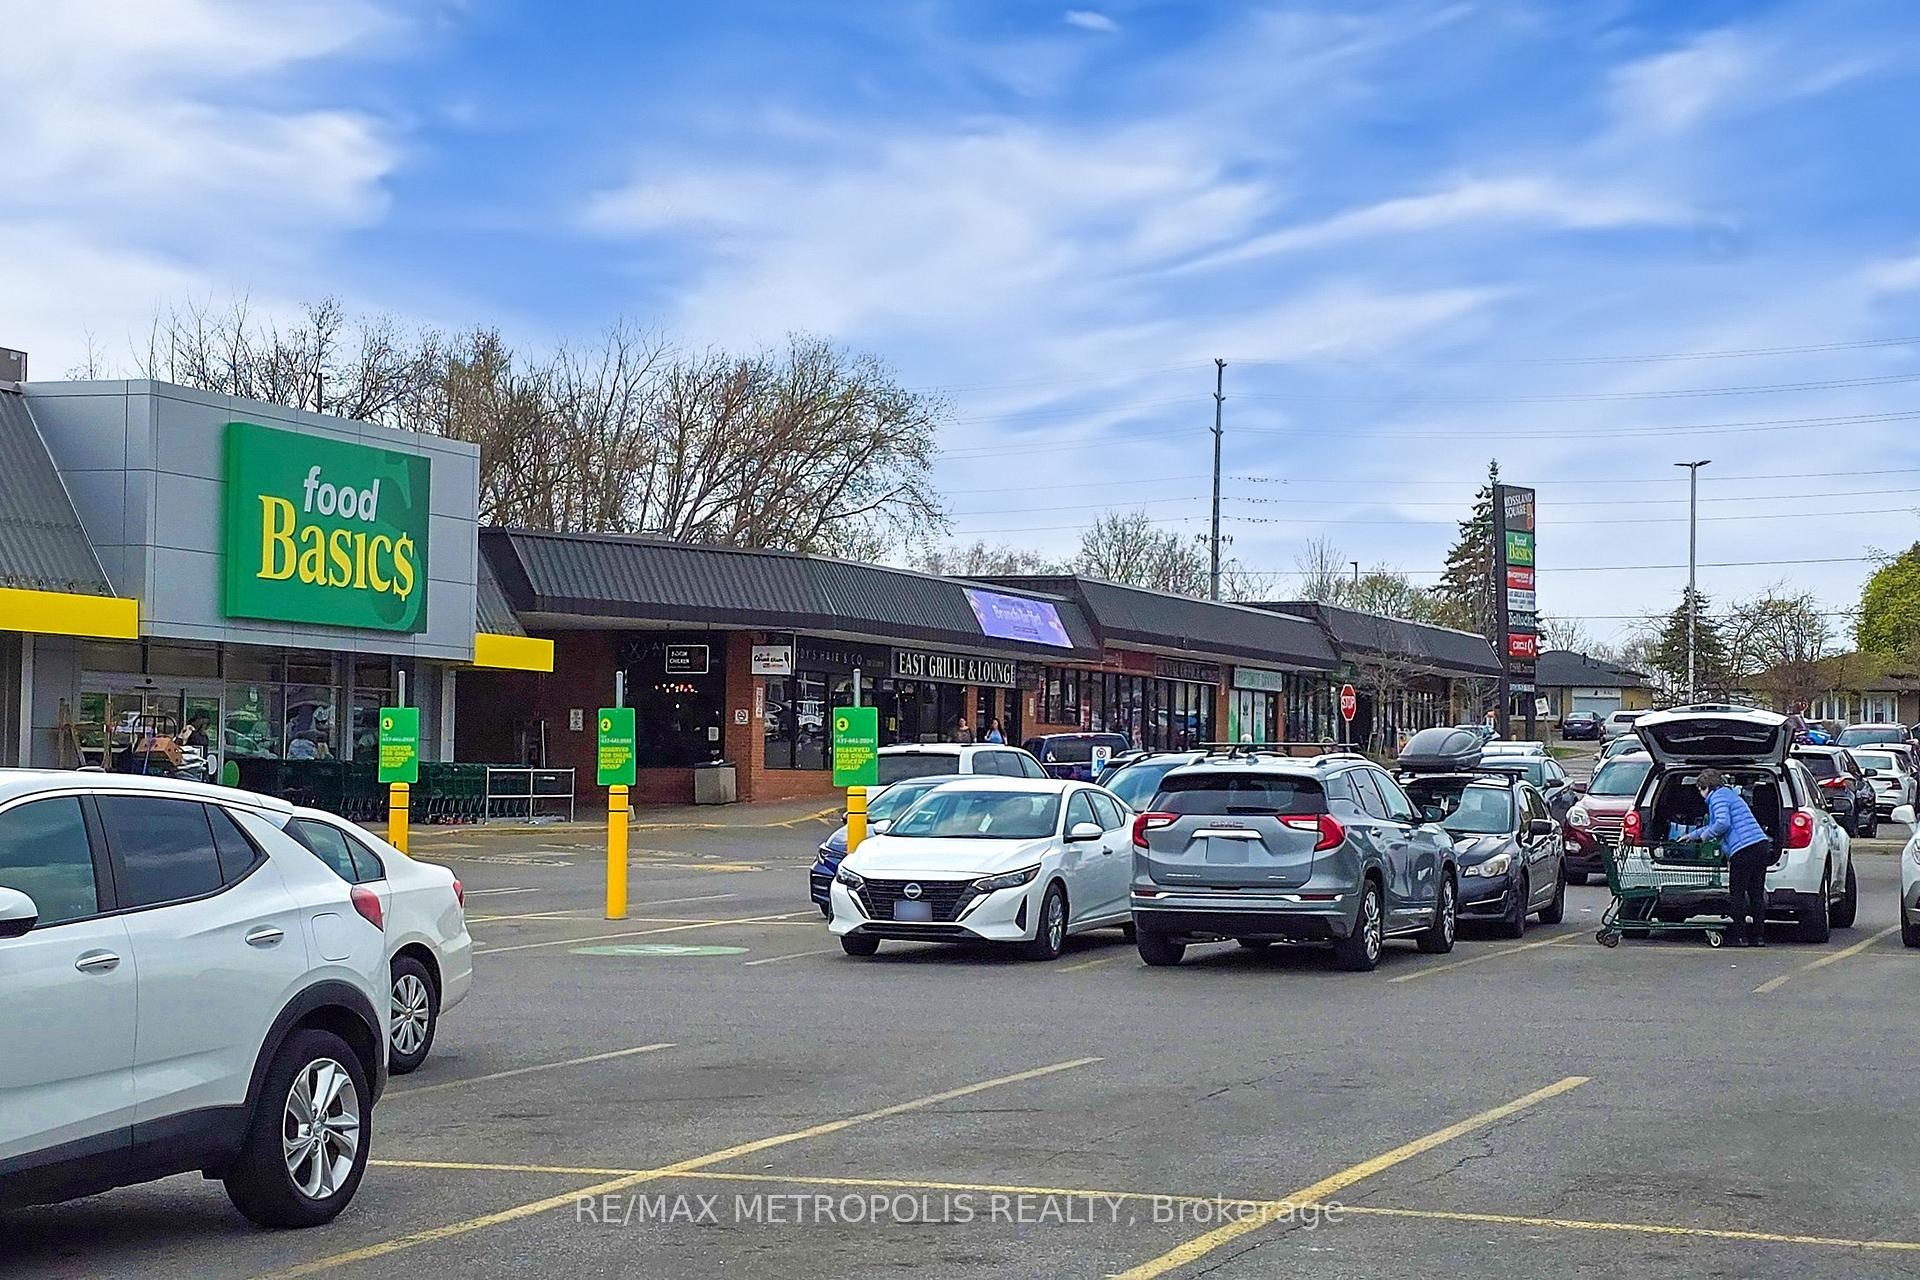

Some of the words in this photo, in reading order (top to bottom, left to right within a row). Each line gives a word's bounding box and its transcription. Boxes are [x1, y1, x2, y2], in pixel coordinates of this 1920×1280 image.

[303, 465, 380, 522] food
[1505, 504, 1526, 518] SQUARE
[899, 652, 926, 676] EAST
[929, 655, 965, 680] GRILLE
[968, 660, 977, 681] &
[978, 660, 1017, 684] LOUNGE
[1341, 696, 1356, 708] STOP
